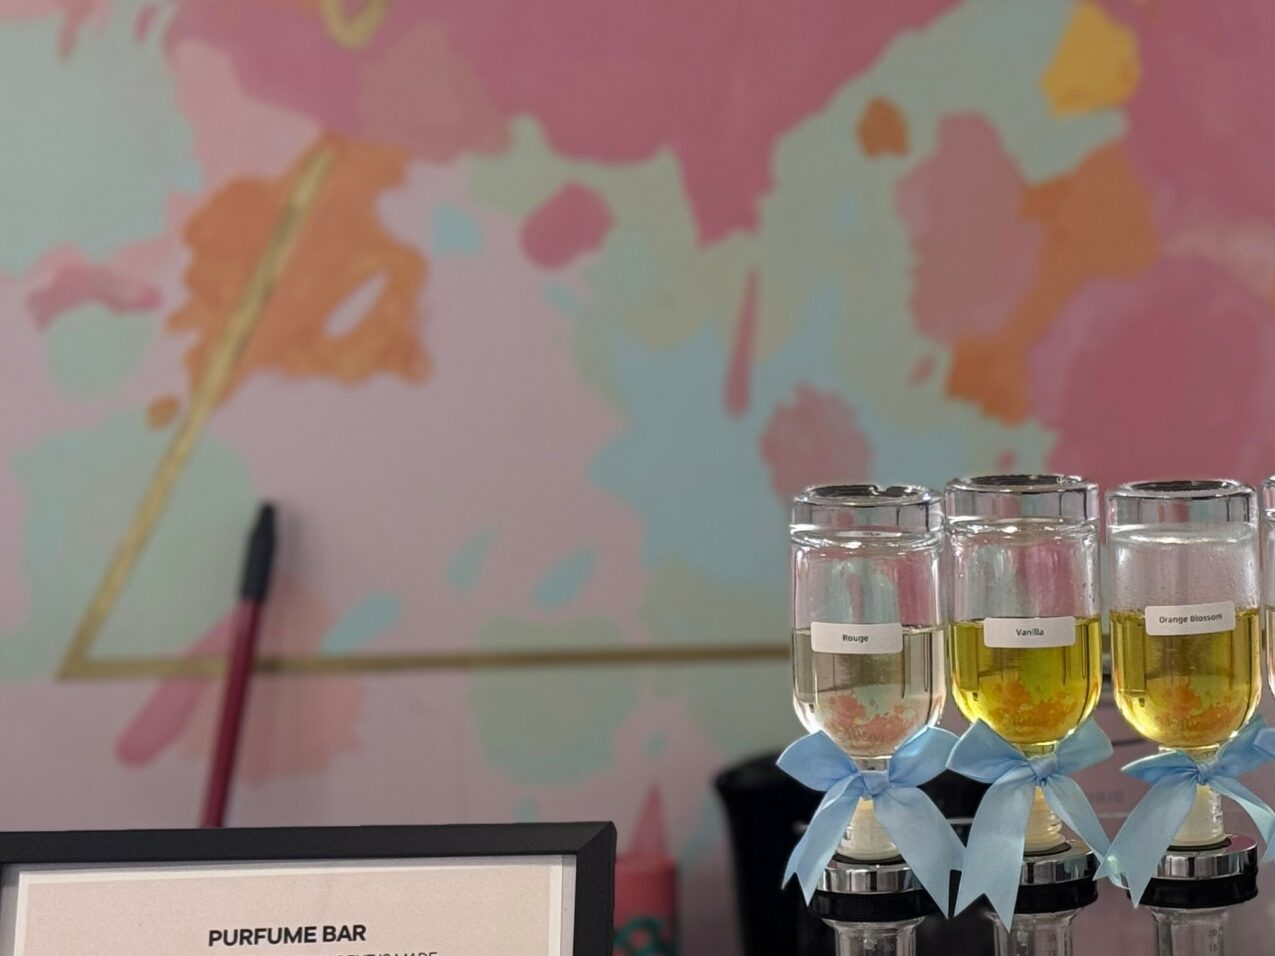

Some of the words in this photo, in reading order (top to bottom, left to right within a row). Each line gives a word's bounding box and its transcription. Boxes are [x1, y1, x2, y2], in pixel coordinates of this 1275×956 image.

[1159, 615, 1188, 625] Orange
[1190, 613, 1223, 622] Blossom
[1015, 628, 1045, 637] Vanilla
[842, 634, 870, 644] Rouge
[208, 926, 318, 947] PURFUME
[322, 924, 367, 943] BAR
